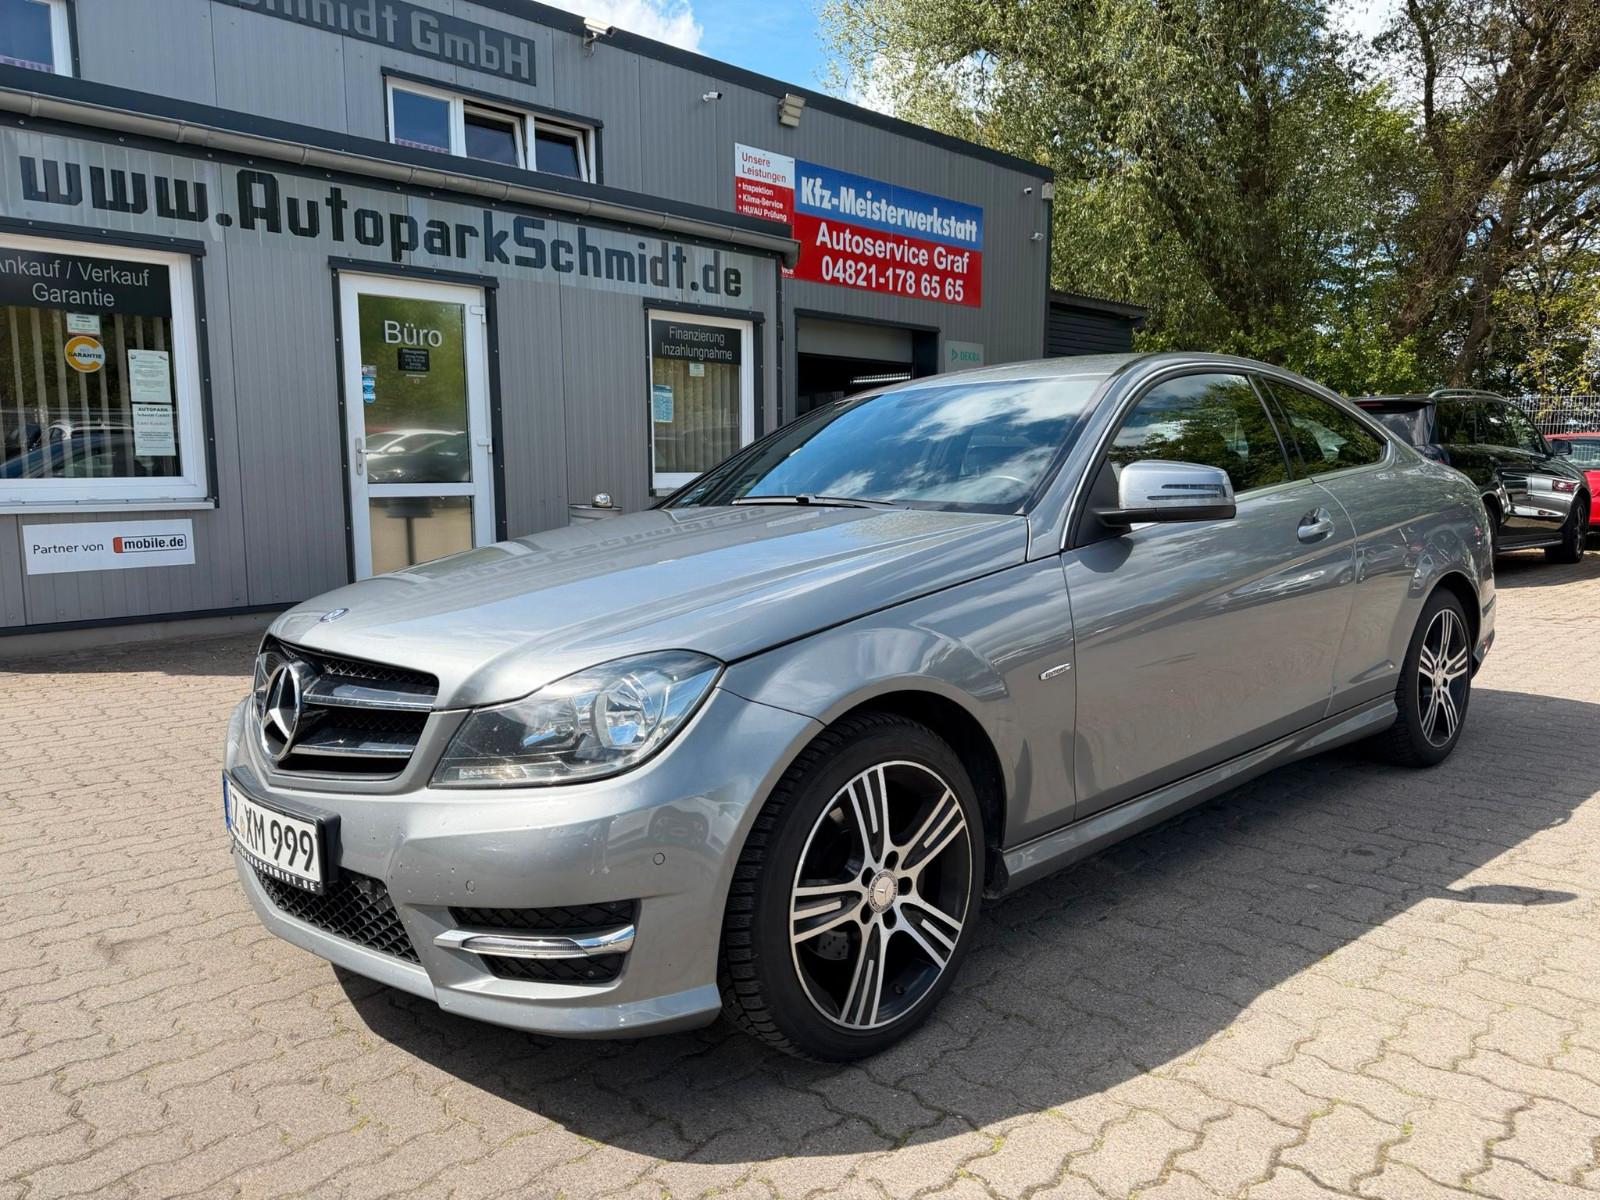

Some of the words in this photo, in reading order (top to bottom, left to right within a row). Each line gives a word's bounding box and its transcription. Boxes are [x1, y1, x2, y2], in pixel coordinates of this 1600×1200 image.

[238, 0, 397, 43] midt
[411, 11, 529, 80] GmbH
[742, 152, 770, 167] Unsere
[742, 164, 786, 182] Leistungen
[742, 182, 774, 196] Inspektion
[742, 194, 784, 209] Klima-Service
[801, 176, 977, 242] Kfz-Meisterwerkstatt
[19, 155, 742, 298] www.AutoparkSchmidt.de
[763, 209, 787, 222] Prüfung
[816, 222, 928, 266] Autoservice
[934, 246, 969, 274] Graf
[77, 262, 149, 286] Verkauf
[822, 255, 915, 294] 04821-178
[921, 273, 940, 298] 65
[944, 278, 964, 302] 65
[32, 282, 115, 307] Garantie
[384, 320, 442, 347] Büro
[669, 326, 725, 346] Finanzierung
[661, 342, 732, 360] Inzahlungnahme
[33, 544, 77, 554] Partner
[82, 543, 104, 552] von
[124, 537, 184, 549] mobile.de
[244, 804, 266, 855] XM
[270, 819, 314, 872] 999
